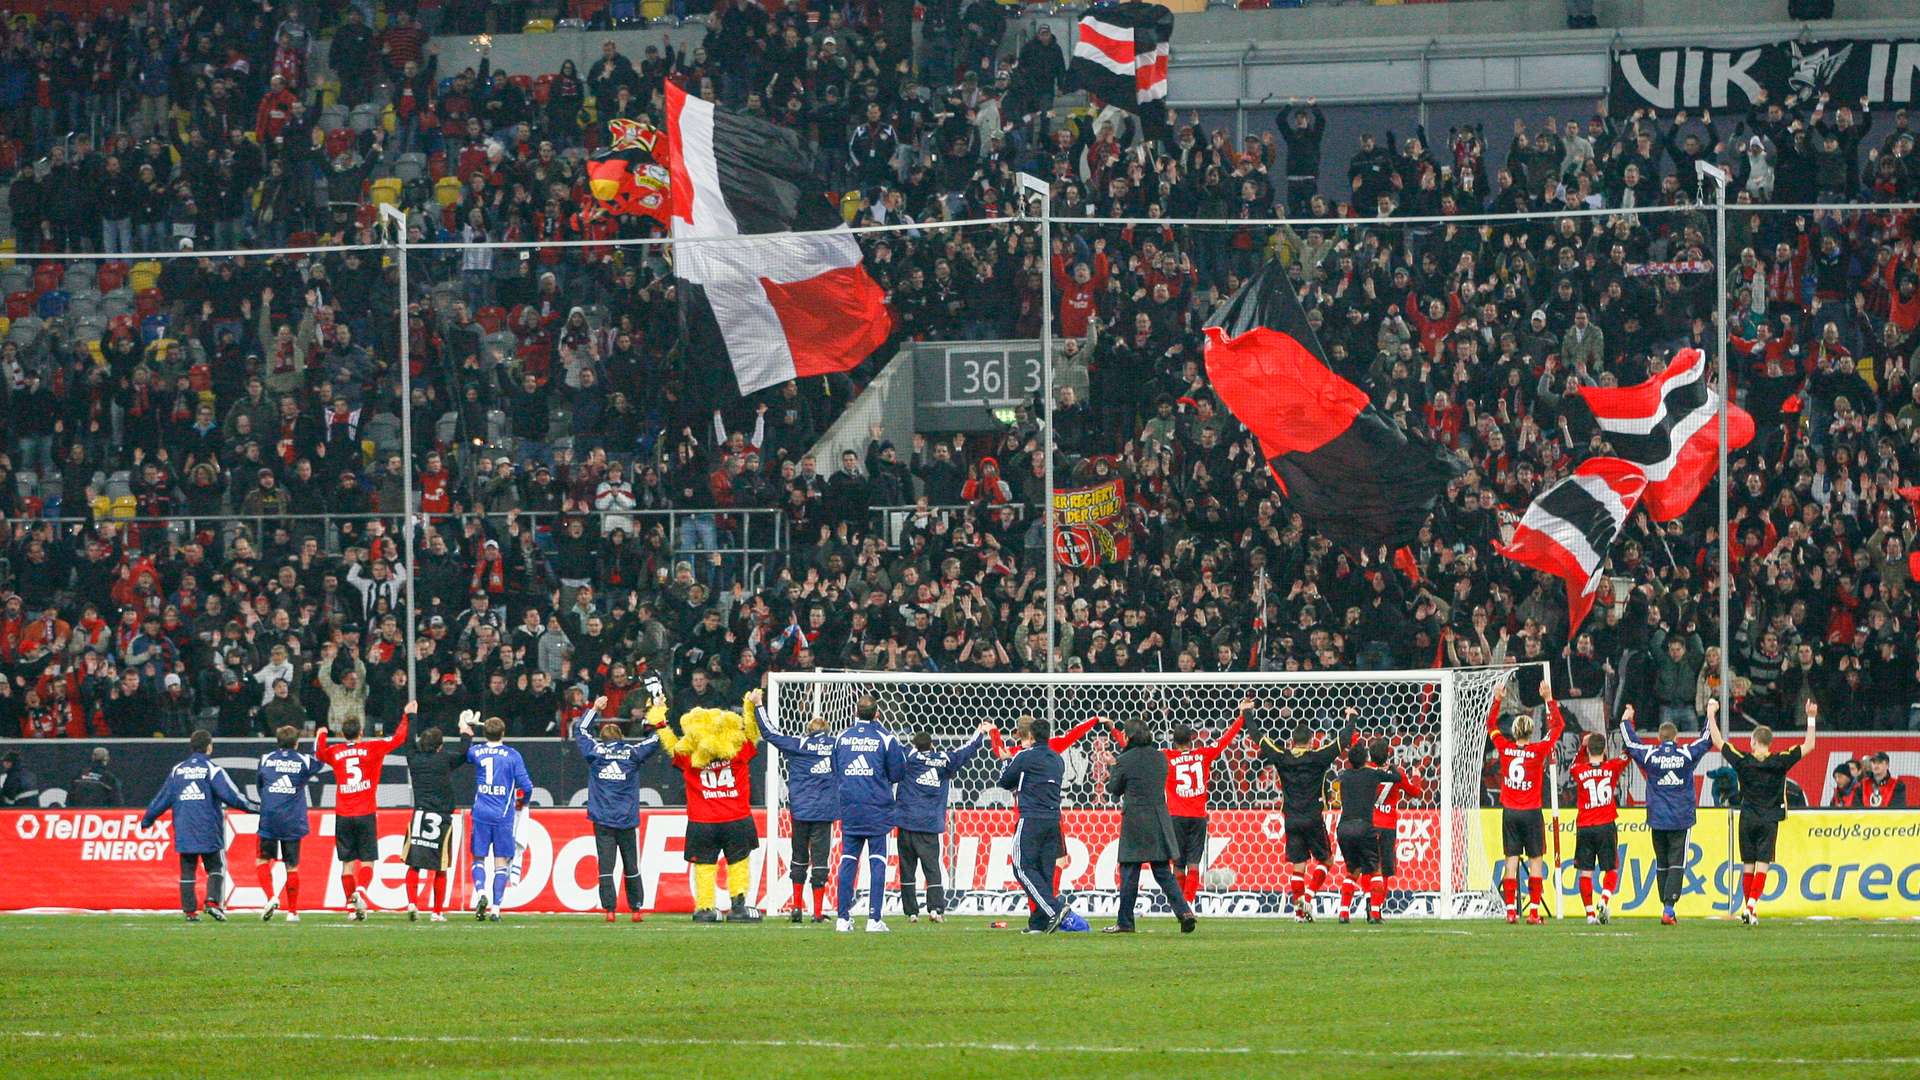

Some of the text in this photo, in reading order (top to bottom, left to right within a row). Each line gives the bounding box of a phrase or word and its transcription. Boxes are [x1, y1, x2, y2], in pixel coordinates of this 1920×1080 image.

[1620, 49, 1762, 109] VIK
[963, 360, 1001, 393] 36
[1024, 359, 1050, 392] 3
[346, 757, 363, 786] 5
[480, 756, 494, 785] 1
[700, 768, 736, 789] 04
[844, 767, 874, 776] adidas
[1176, 761, 1205, 792] 51
[1508, 756, 1526, 783] 6
[268, 786, 297, 794] adidas
[1374, 781, 1394, 805] 7
[1583, 777, 1613, 809] 16
[44, 814, 172, 840] TelDaFax
[411, 810, 443, 841] 13
[1808, 823, 1881, 841] ready&go
[81, 840, 170, 861] ENERGY
